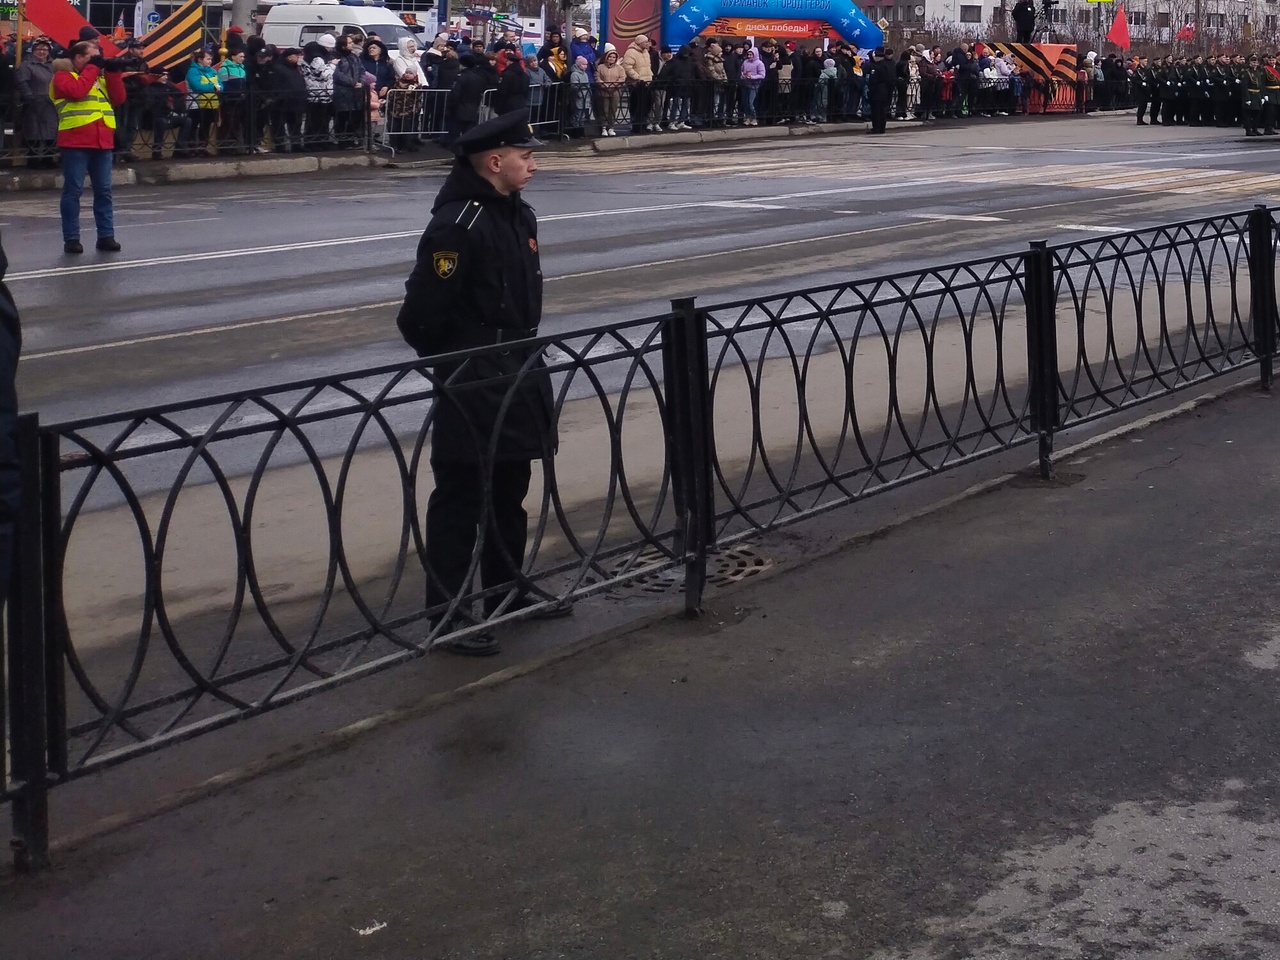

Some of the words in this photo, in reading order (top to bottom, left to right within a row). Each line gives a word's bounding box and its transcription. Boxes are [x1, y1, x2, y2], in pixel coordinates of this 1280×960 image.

[806, 0, 831, 10] ГЕРОЙ
[745, 24, 769, 32] днем
[771, 23, 809, 33] победы!
